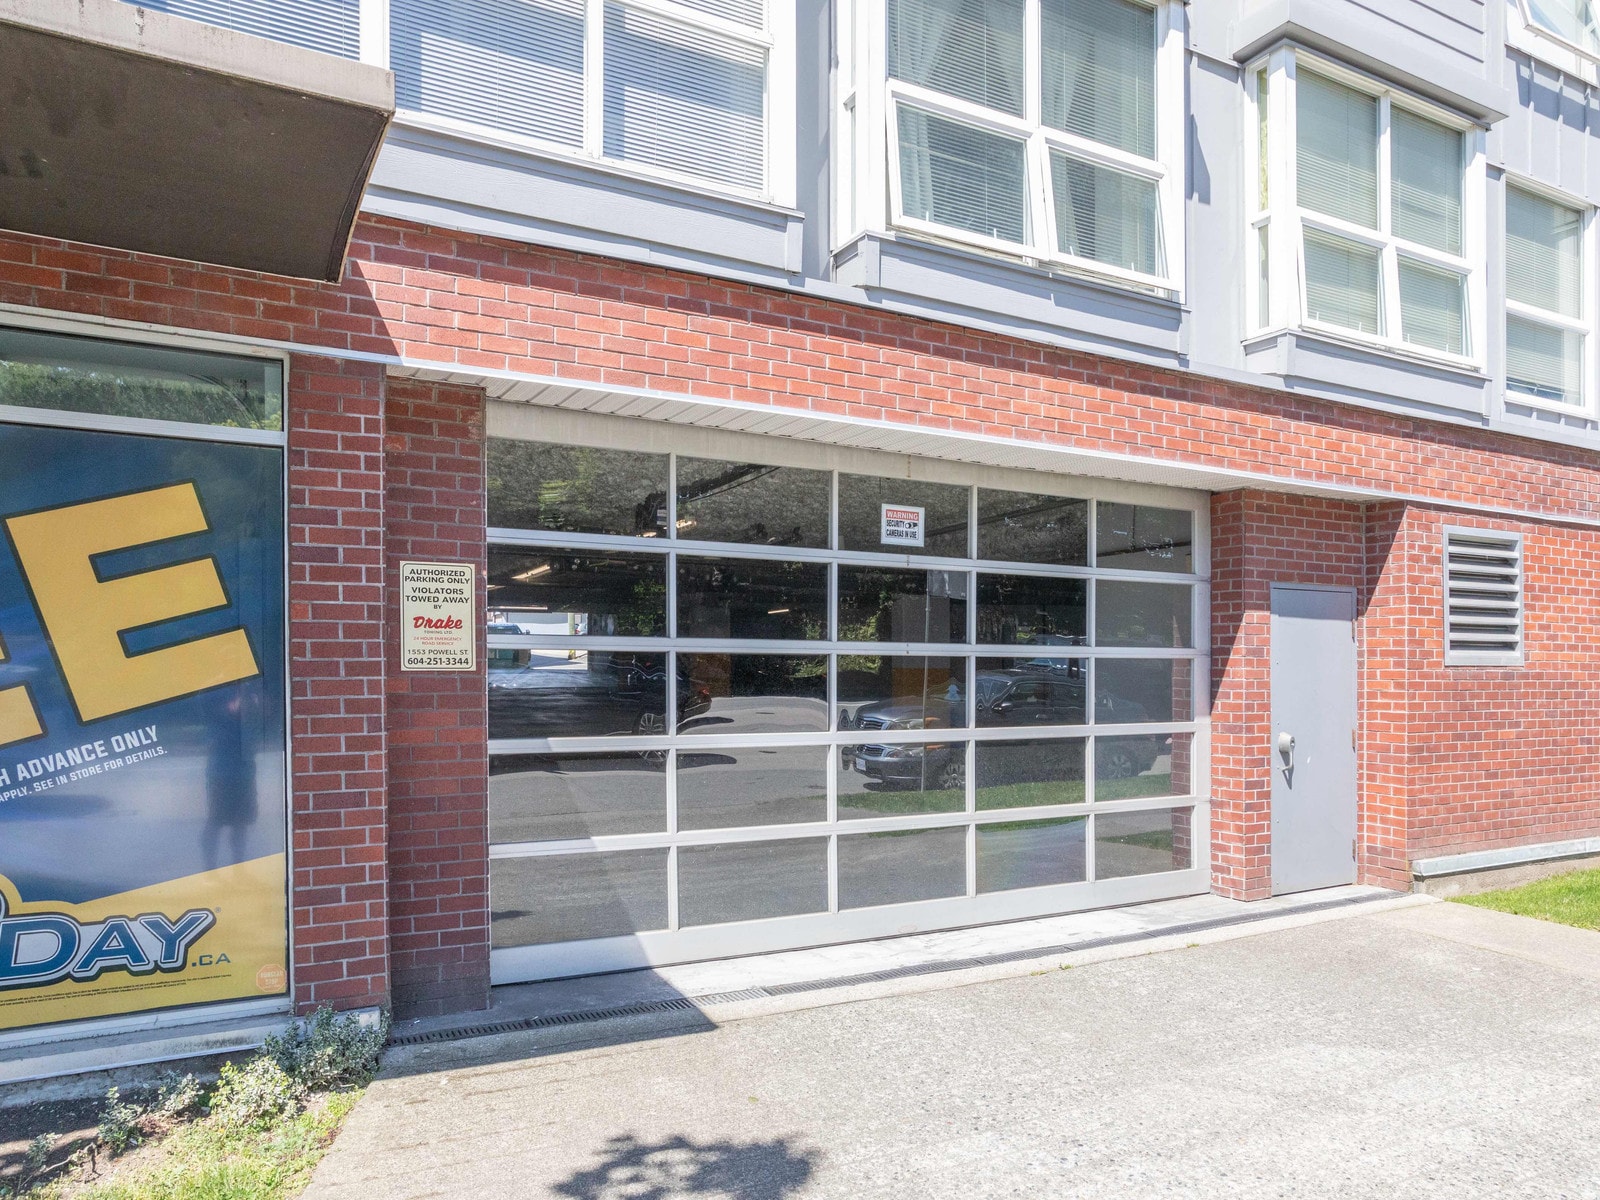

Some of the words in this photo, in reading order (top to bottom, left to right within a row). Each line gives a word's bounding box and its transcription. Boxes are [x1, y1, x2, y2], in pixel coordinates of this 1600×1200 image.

[886, 510, 918, 520] WARNING
[887, 520, 905, 528] SECURITY
[886, 529, 904, 537] CAMERAS
[904, 530, 909, 538] IN
[909, 531, 917, 539] USE
[409, 569, 465, 577] AUTHORIZED
[404, 575, 445, 584] PARKING
[447, 577, 470, 585] ONLY
[411, 587, 464, 595] VIOLATORS
[405, 595, 440, 603] TOWED
[442, 596, 470, 604] AWAY
[0, 477, 262, 747] E
[413, 615, 463, 629] Drake
[407, 657, 469, 666] 604-251-3344
[16, 740, 108, 782] ADVANCE
[110, 725, 158, 753] ONLY
[33, 779, 54, 792] SEE
[56, 774, 68, 786] IN
[70, 764, 103, 781] STORE
[104, 758, 124, 771] FOR
[126, 746, 168, 765] DETAILS.
